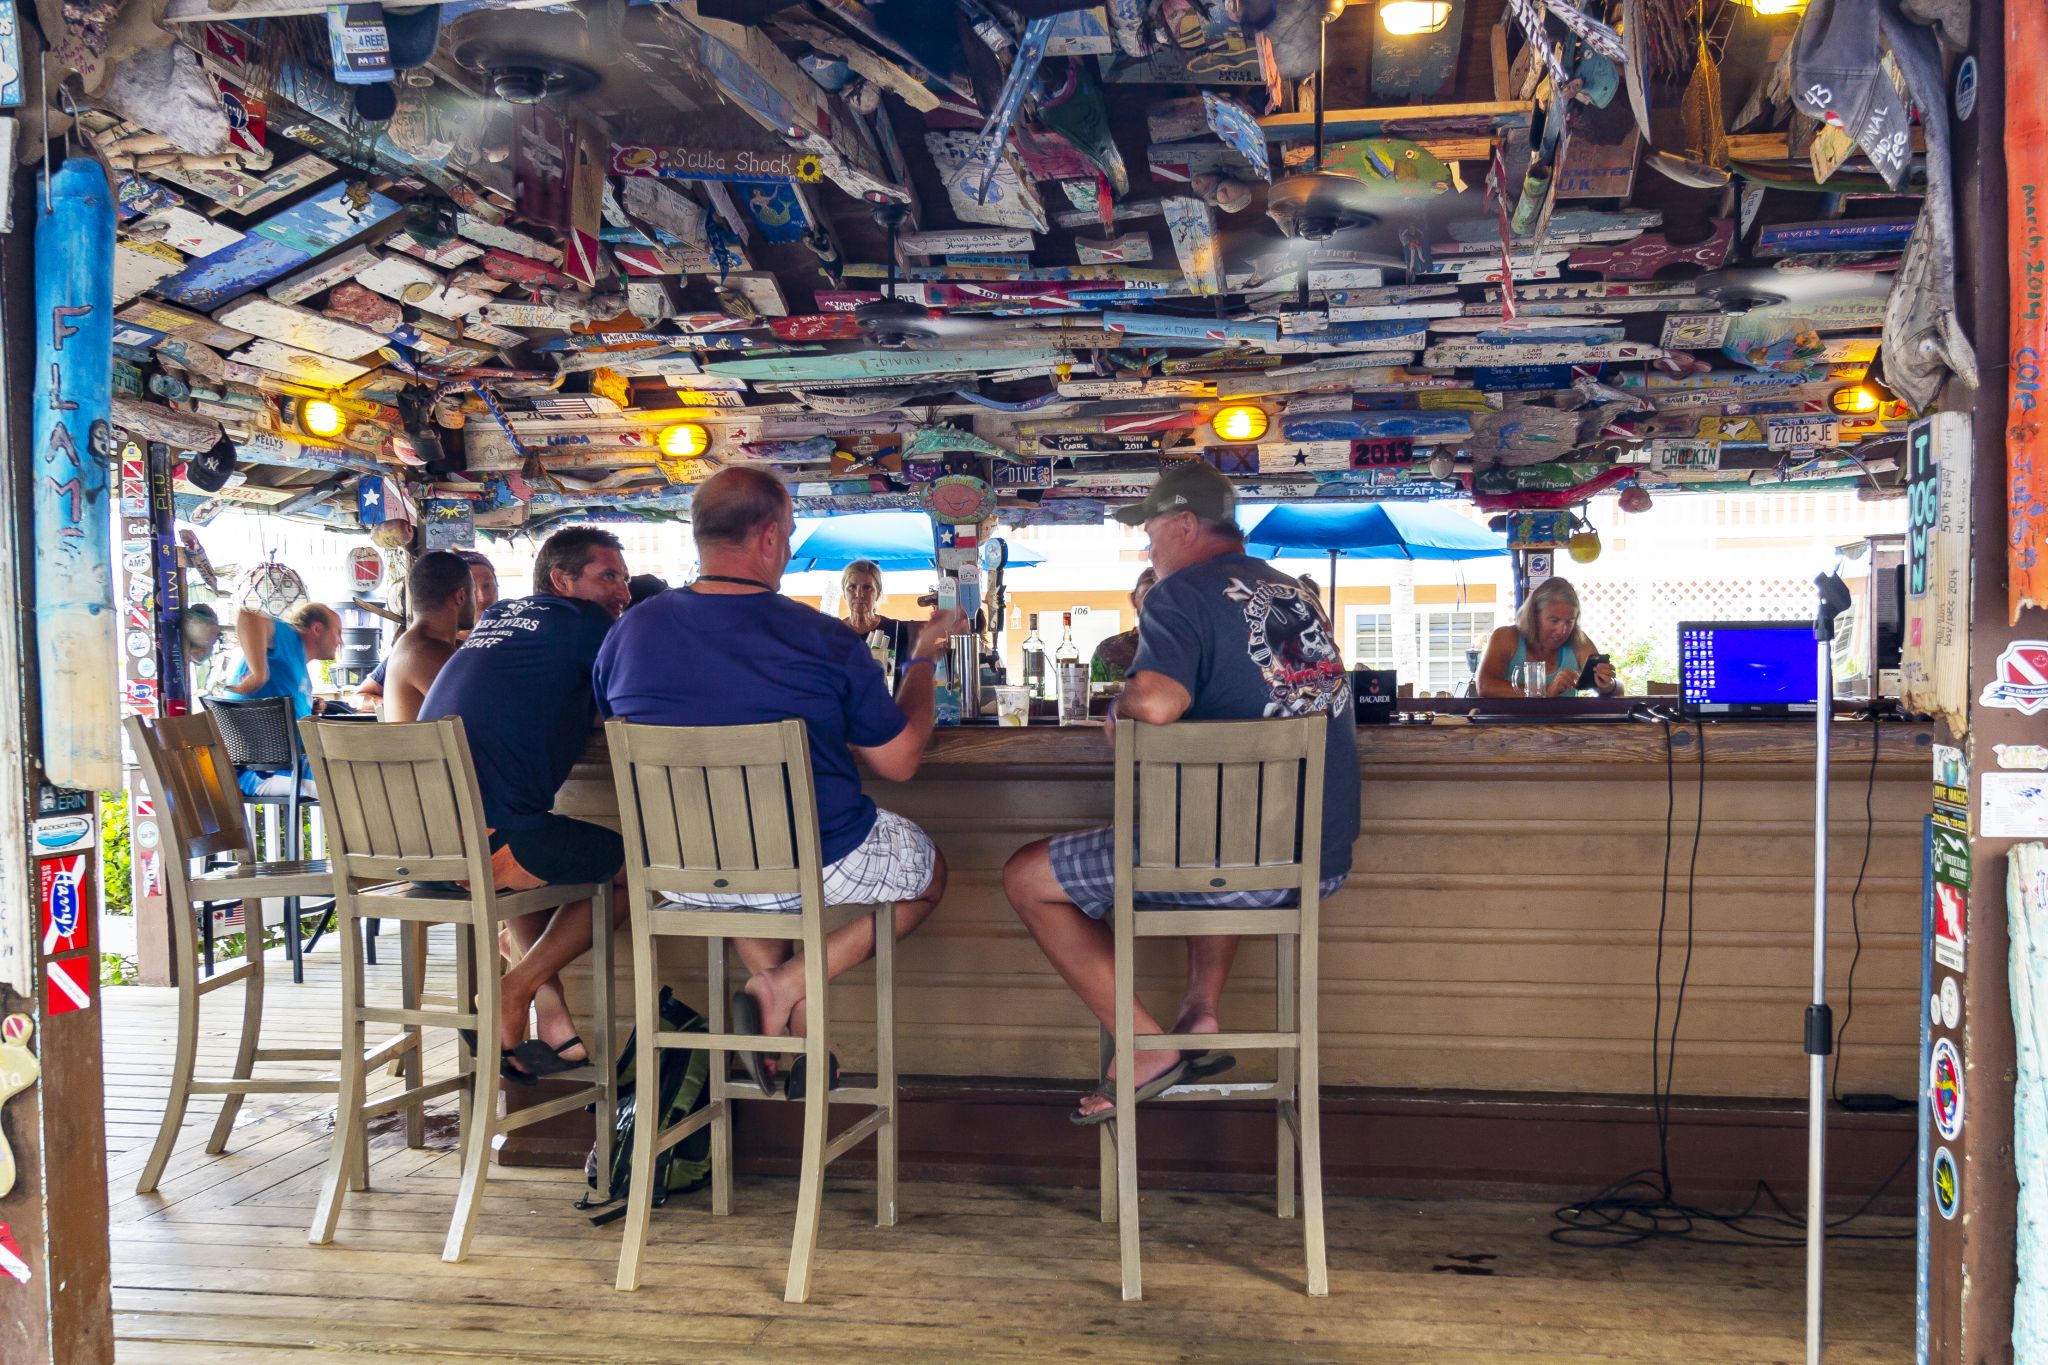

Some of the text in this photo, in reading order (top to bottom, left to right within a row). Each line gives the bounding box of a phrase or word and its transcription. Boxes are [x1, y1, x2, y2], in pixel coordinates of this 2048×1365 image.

[1804, 83, 1833, 109] 43
[674, 148, 792, 175] Scuba Shack
[1127, 280, 1160, 290] 2015
[2022, 259, 2046, 321] 2014
[1118, 434, 1149, 442] VIRGINIA
[1774, 424, 1833, 445] 22783 JE
[1124, 442, 1143, 450] 2011
[1206, 446, 1254, 475] TX
[1354, 443, 1414, 466] 2013
[1008, 467, 1037, 483] DIVE
[1348, 488, 1385, 496] DIVE
[1391, 486, 1434, 496] TEAM
[1517, 478, 1572, 490] HONEYMOON
[155, 473, 168, 511] PLU
[128, 523, 150, 536] Got
[128, 558, 147, 568] AMF
[1074, 606, 1089, 616] 106
[493, 617, 540, 632] DIVERS
[463, 637, 504, 649] STAFF
[1359, 695, 1390, 704] BACARDI
[57, 792, 87, 810] ERIN
[50, 870, 79, 935] Harry's
